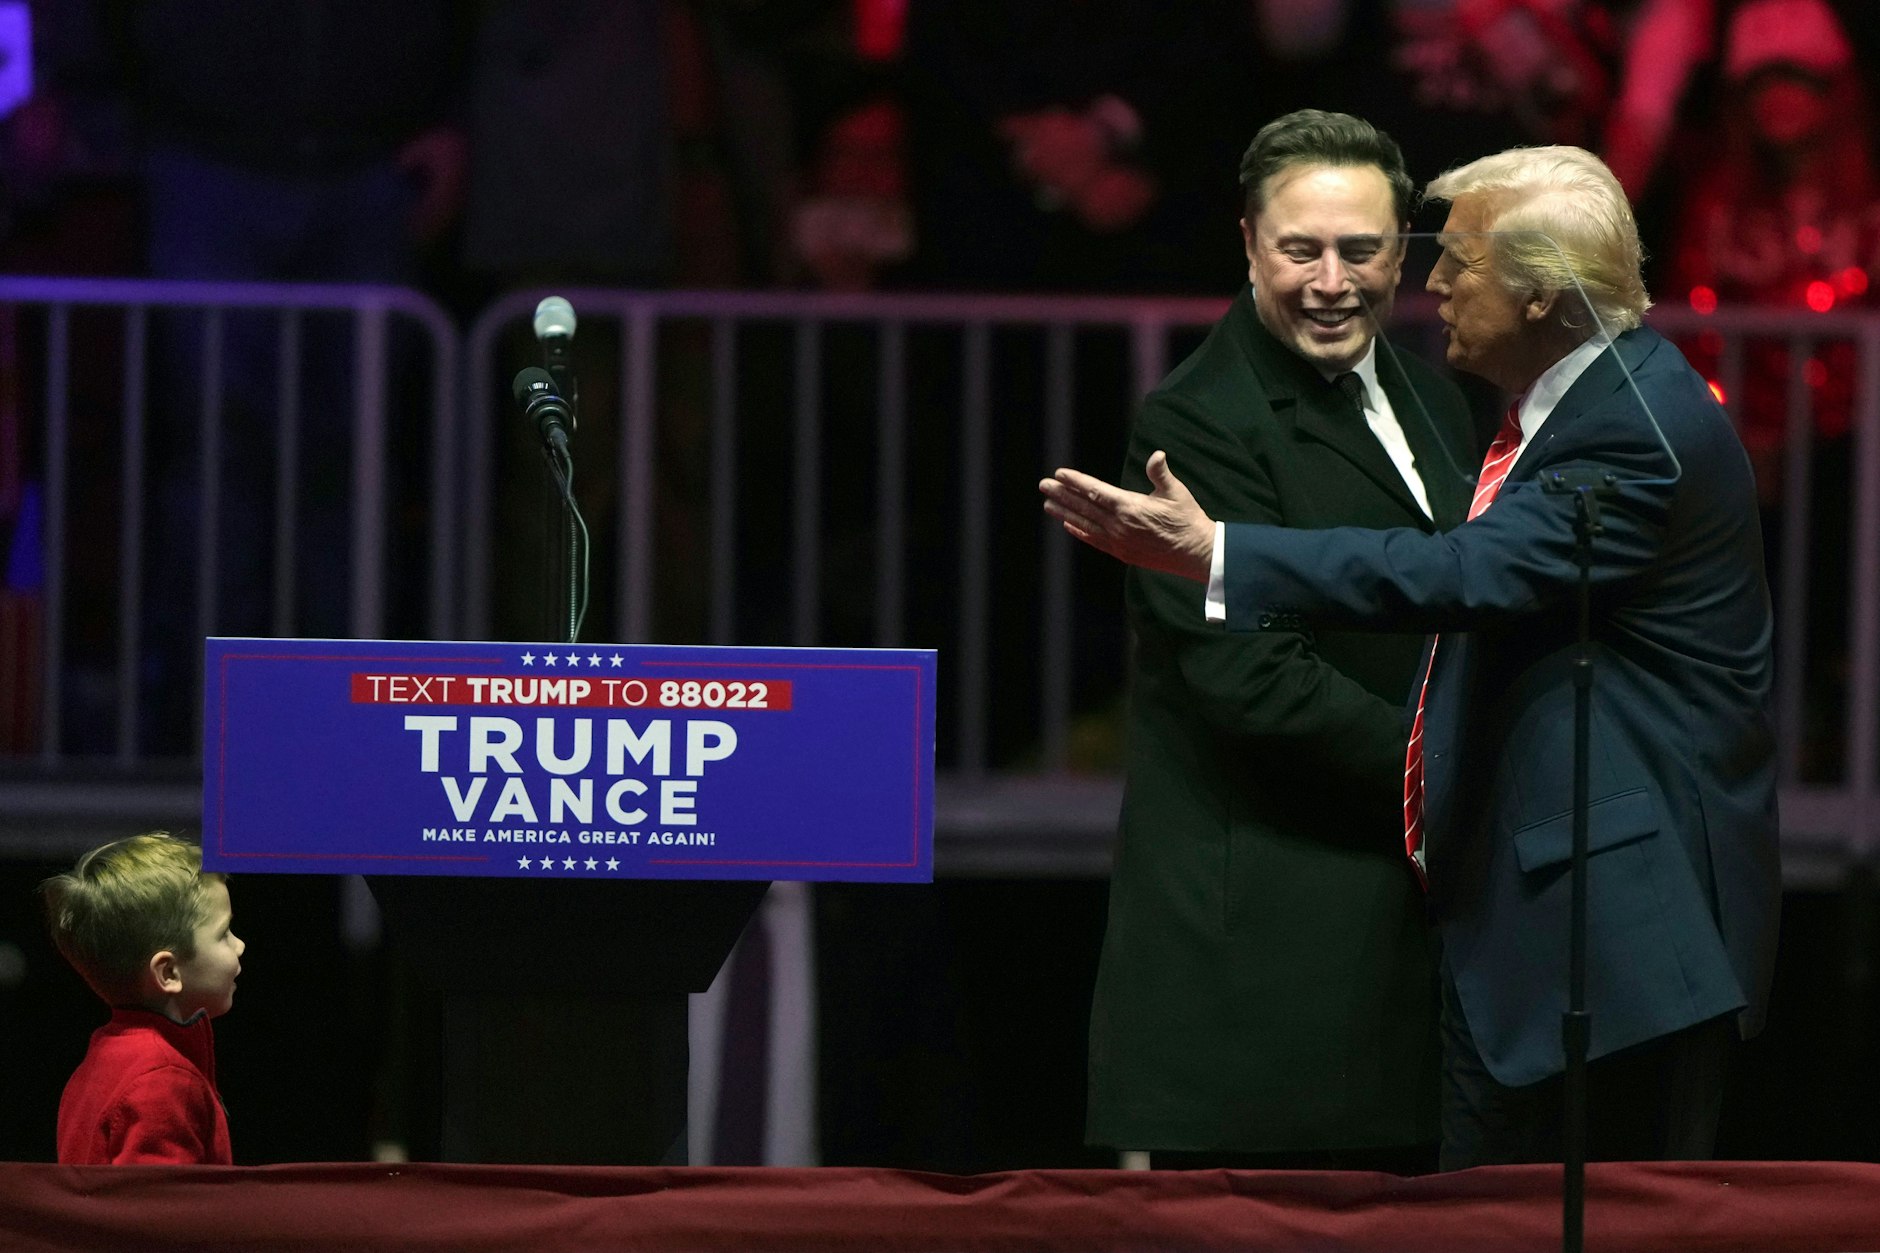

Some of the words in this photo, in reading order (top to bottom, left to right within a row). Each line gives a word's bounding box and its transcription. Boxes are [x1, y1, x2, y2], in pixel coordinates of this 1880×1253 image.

[367, 677, 456, 703] TEXT
[467, 678, 592, 705] TRUMP
[602, 680, 648, 706] TO
[660, 681, 769, 708] 88022
[405, 716, 738, 776] TRUMP
[441, 777, 698, 826] VANCE
[423, 829, 477, 843] MAKE
[484, 830, 571, 844] AMERICA
[578, 831, 641, 845] GREAT
[648, 832, 716, 846] AGAIN!
